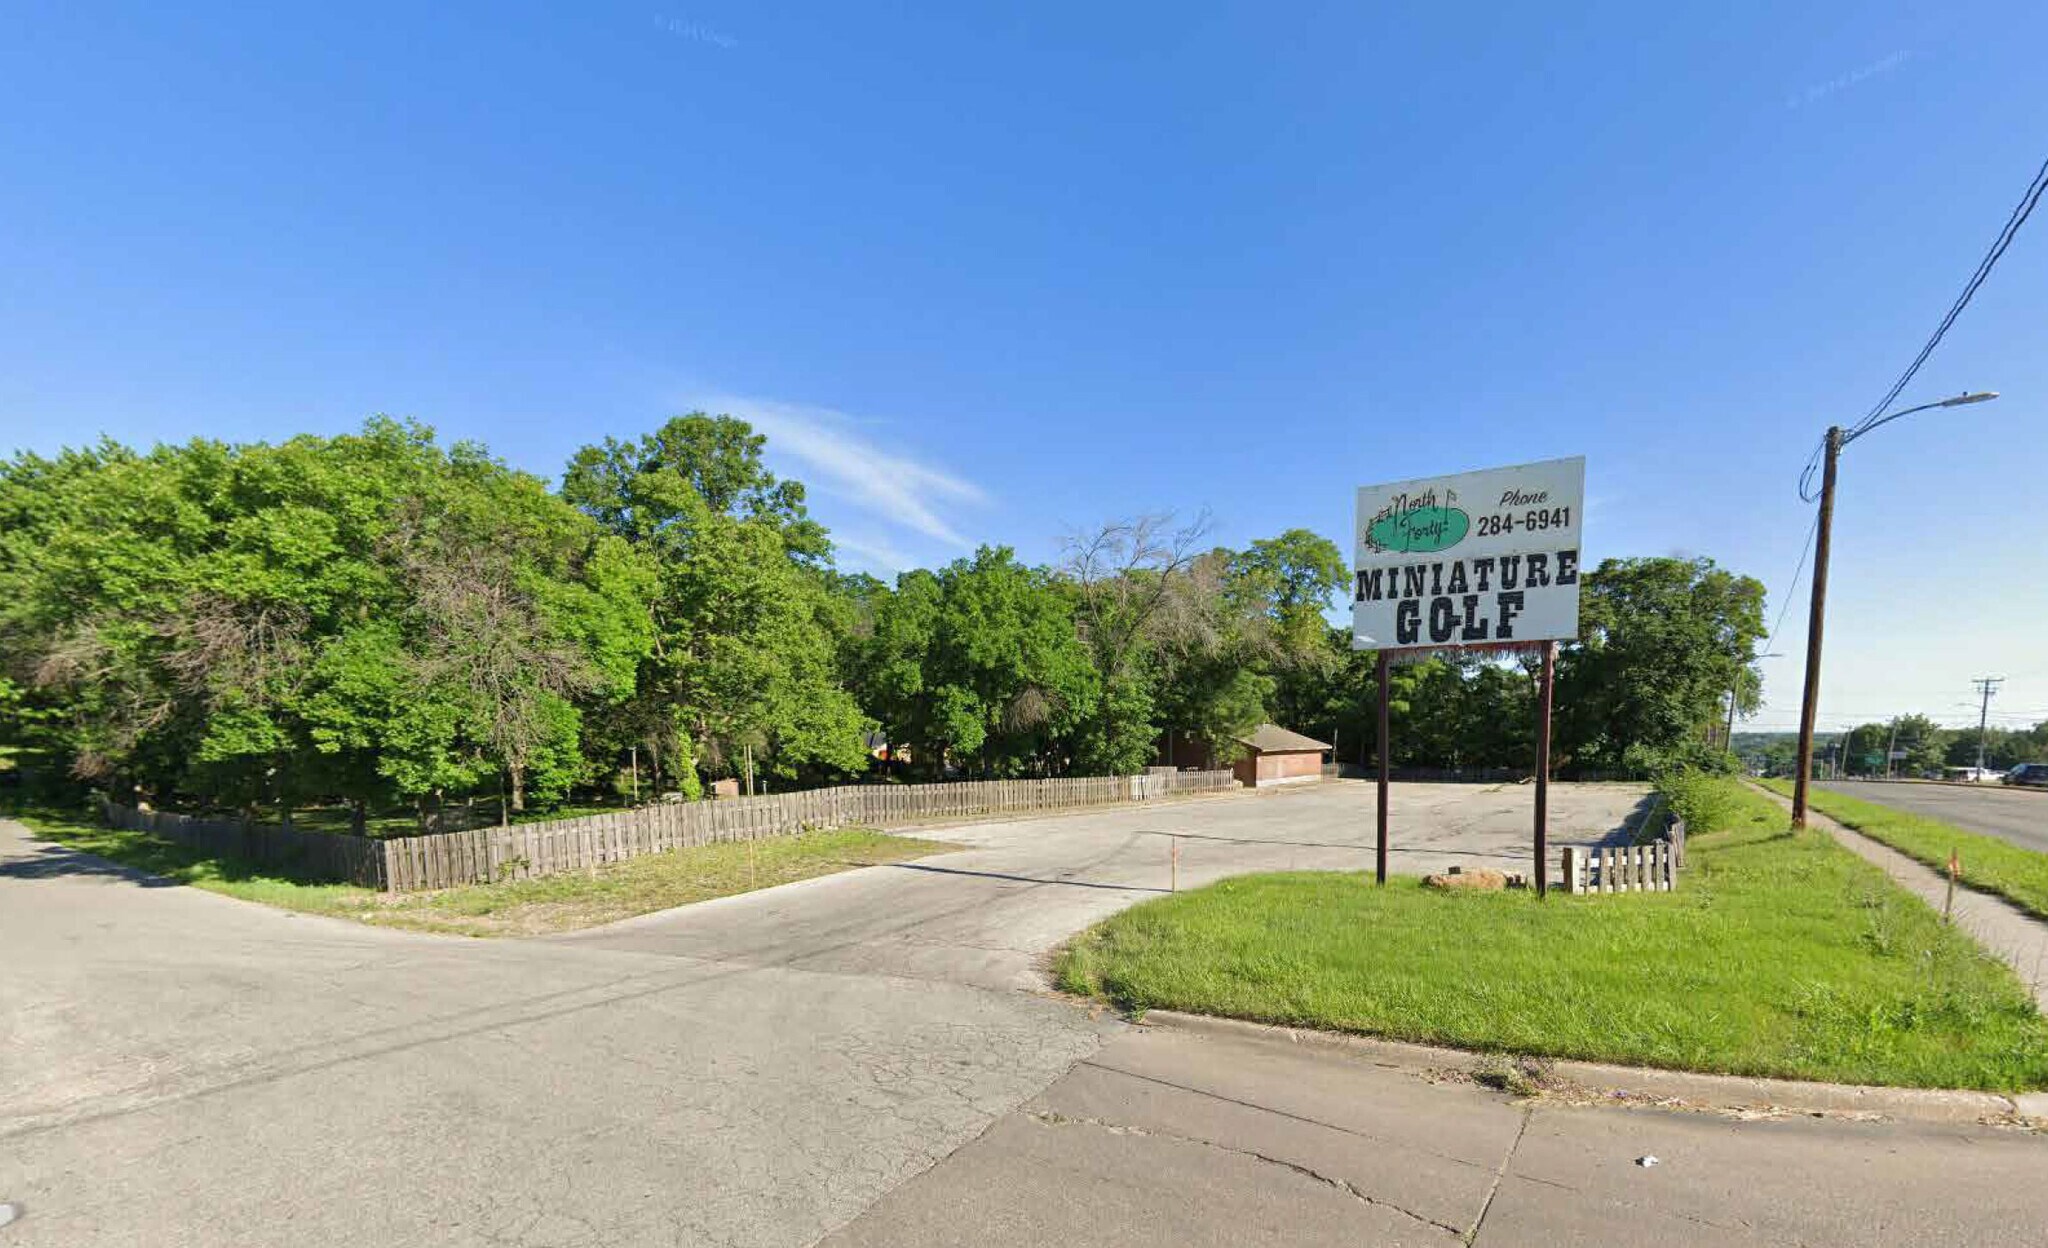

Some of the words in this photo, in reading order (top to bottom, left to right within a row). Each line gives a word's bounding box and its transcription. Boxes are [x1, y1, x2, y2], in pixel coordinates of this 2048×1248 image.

[1392, 488, 1438, 528] North
[1500, 489, 1548, 506] Phone
[1400, 511, 1446, 552] Forty
[1477, 506, 1570, 537] 284-6941
[1356, 551, 1578, 602] MINIATURE
[1396, 591, 1525, 645] GOLF
